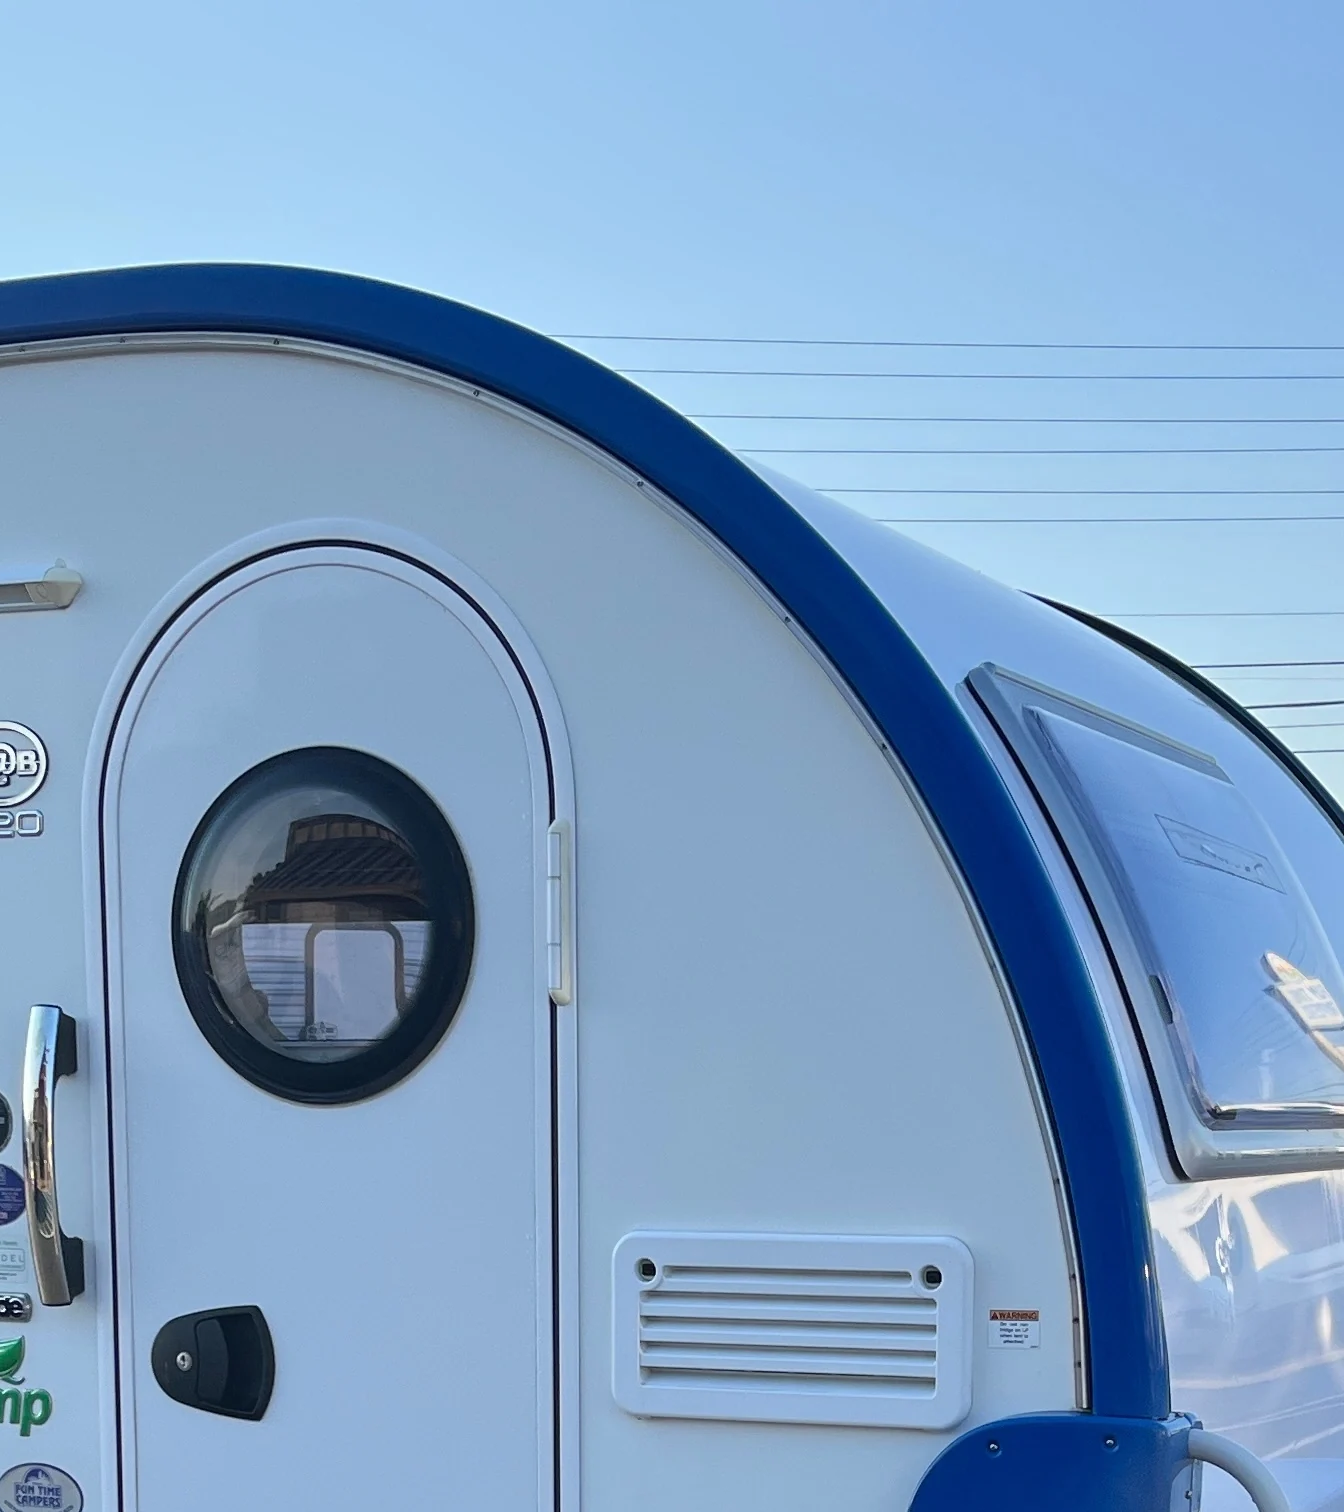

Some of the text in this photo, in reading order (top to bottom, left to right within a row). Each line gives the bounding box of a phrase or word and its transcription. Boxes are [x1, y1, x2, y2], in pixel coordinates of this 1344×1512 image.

[999, 1311, 1037, 1320] WARNING
[15, 1484, 61, 1497] FUN TIME
[15, 1495, 61, 1509] CAMPERS
